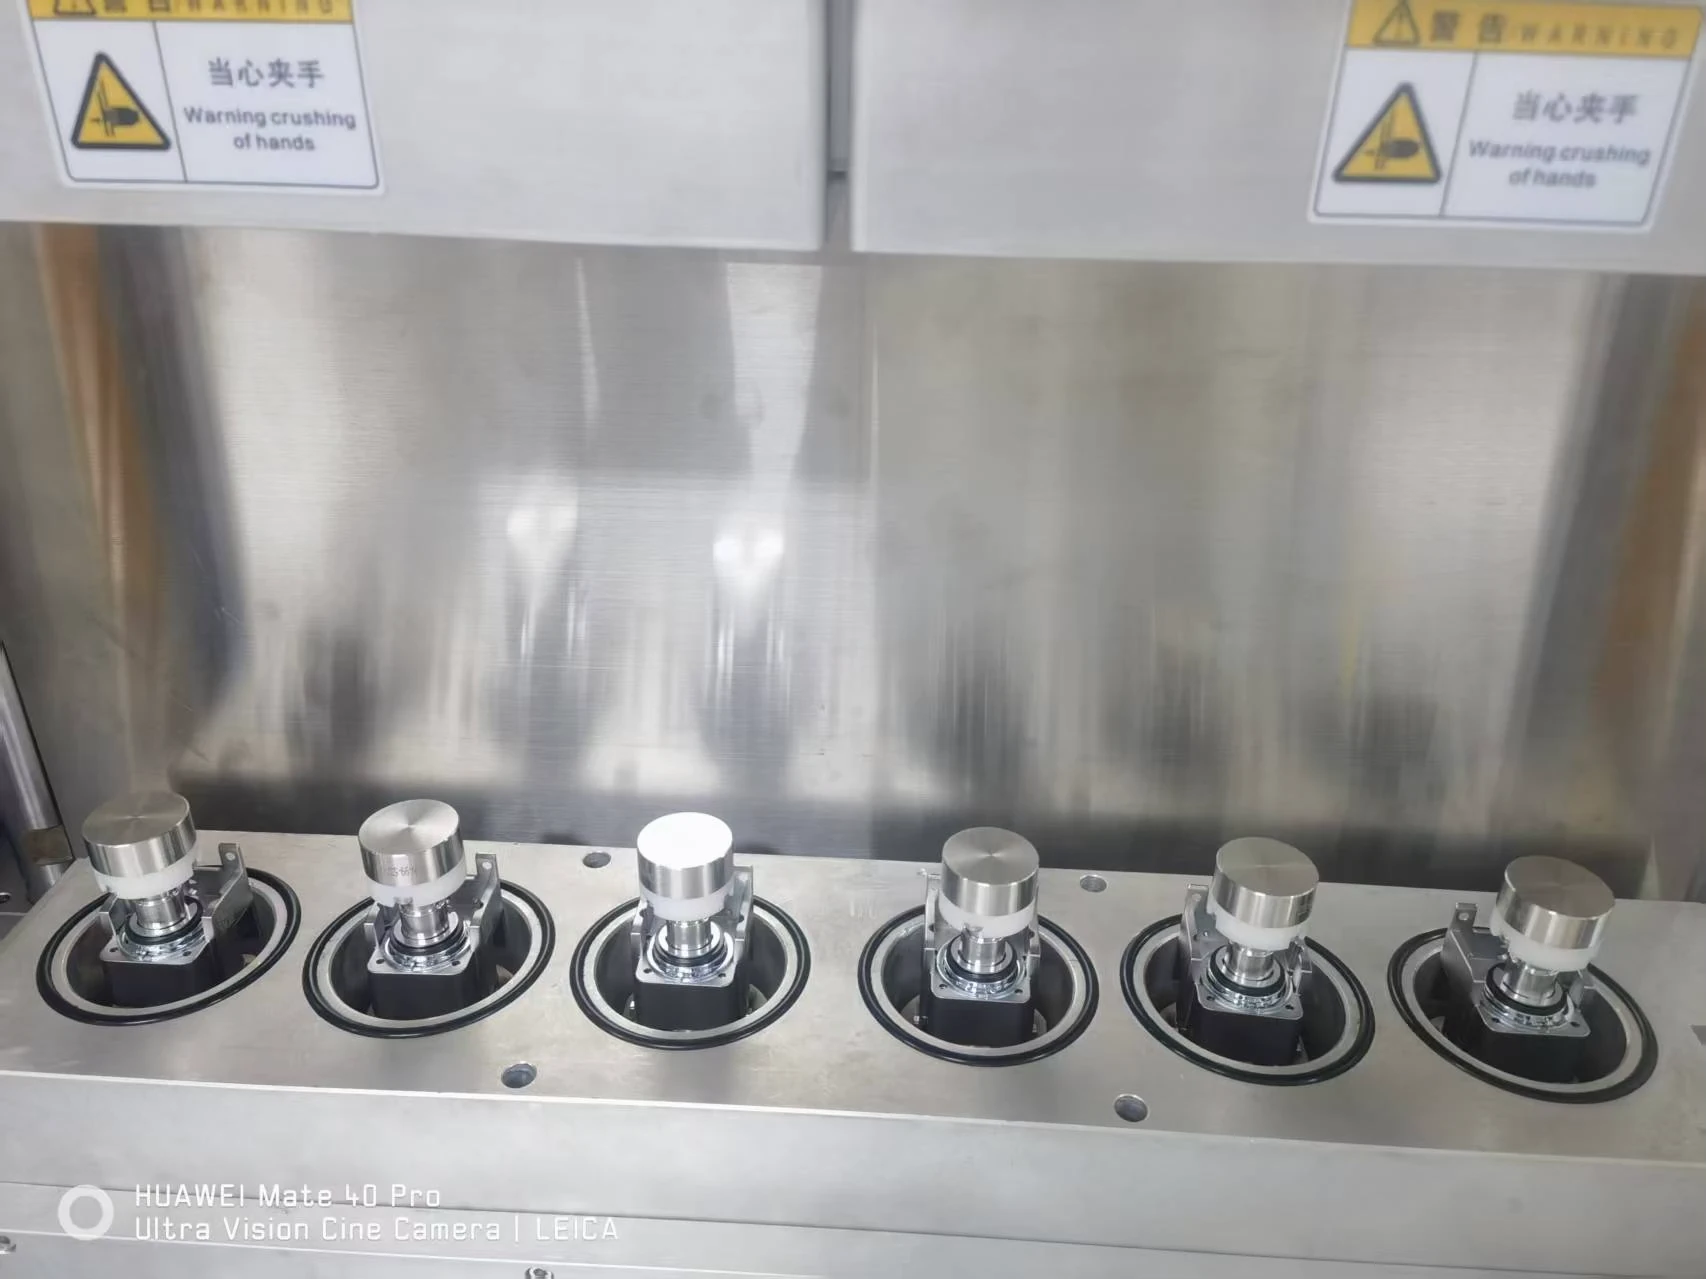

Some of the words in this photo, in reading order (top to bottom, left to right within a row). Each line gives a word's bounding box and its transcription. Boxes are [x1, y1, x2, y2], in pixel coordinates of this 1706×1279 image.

[1520, 22, 1678, 49] WARNING
[208, 57, 325, 89] 当心夹手
[183, 106, 267, 128] Warning
[271, 109, 357, 130] crushing
[1512, 90, 1641, 125] 当心夹手
[233, 133, 252, 151] of
[256, 135, 316, 152] hands
[1469, 138, 1557, 165] Warning
[1559, 144, 1652, 166] crushing
[1508, 169, 1532, 188] of
[1533, 171, 1597, 189] hands
